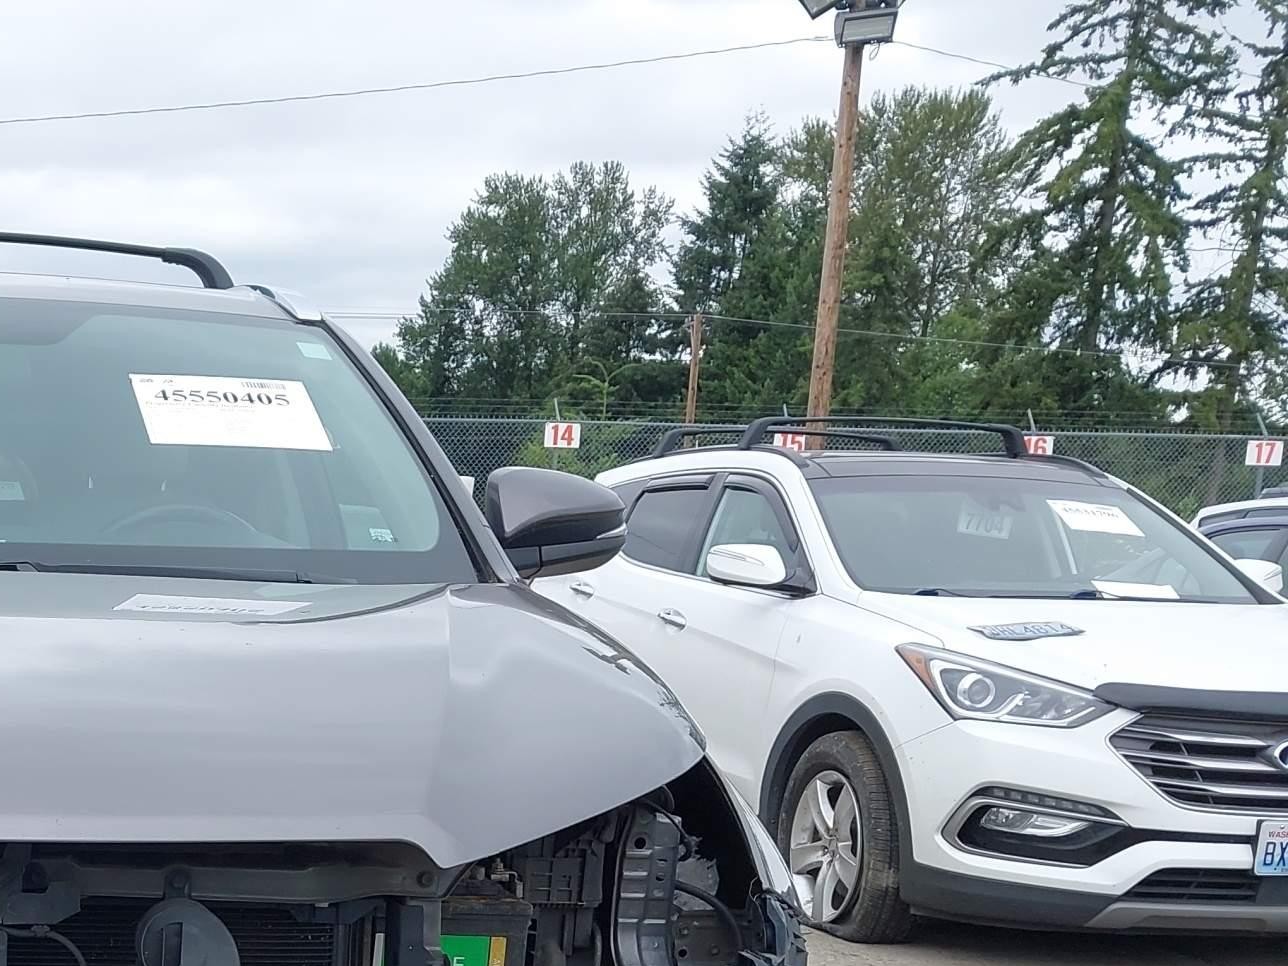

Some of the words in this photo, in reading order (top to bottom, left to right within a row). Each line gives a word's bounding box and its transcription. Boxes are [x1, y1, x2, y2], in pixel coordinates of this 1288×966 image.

[154, 389, 291, 407] 45550405
[551, 424, 575, 446] 14
[780, 432, 804, 452] 15
[1025, 437, 1049, 454] 16
[1255, 442, 1277, 465] 17
[965, 512, 1005, 535] 7704
